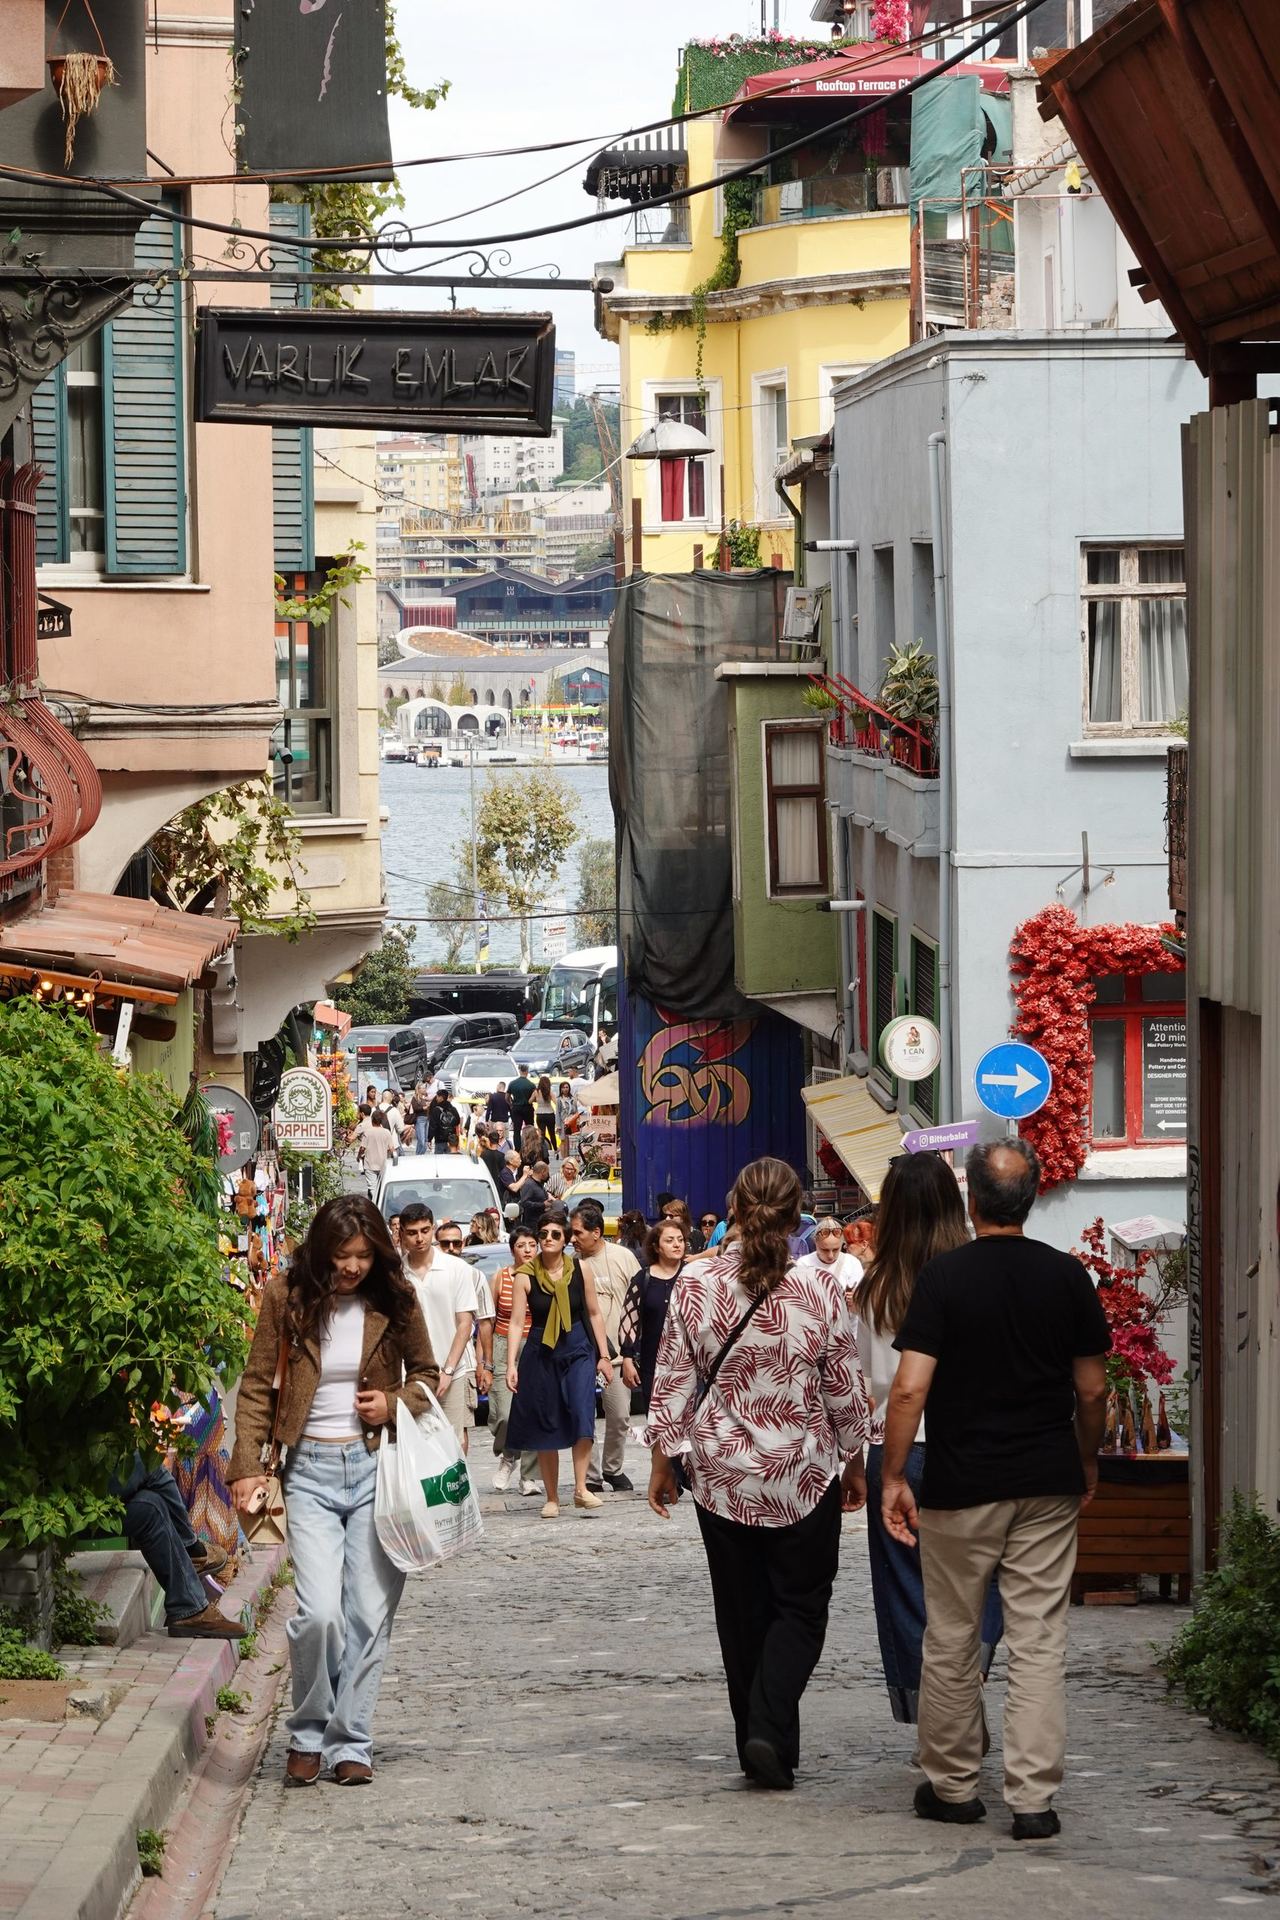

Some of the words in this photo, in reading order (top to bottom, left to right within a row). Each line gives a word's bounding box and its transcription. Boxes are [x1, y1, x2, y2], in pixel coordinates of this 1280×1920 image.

[816, 80, 856, 92] Rooftop
[858, 79, 896, 91] Terrace
[224, 335, 371, 382] VARLIK
[1150, 1023, 1186, 1031] Attentio
[1154, 1033, 1166, 1041] 20
[276, 1124, 325, 1137] DAPHNE
[929, 1131, 968, 1144] Bitterbalat
